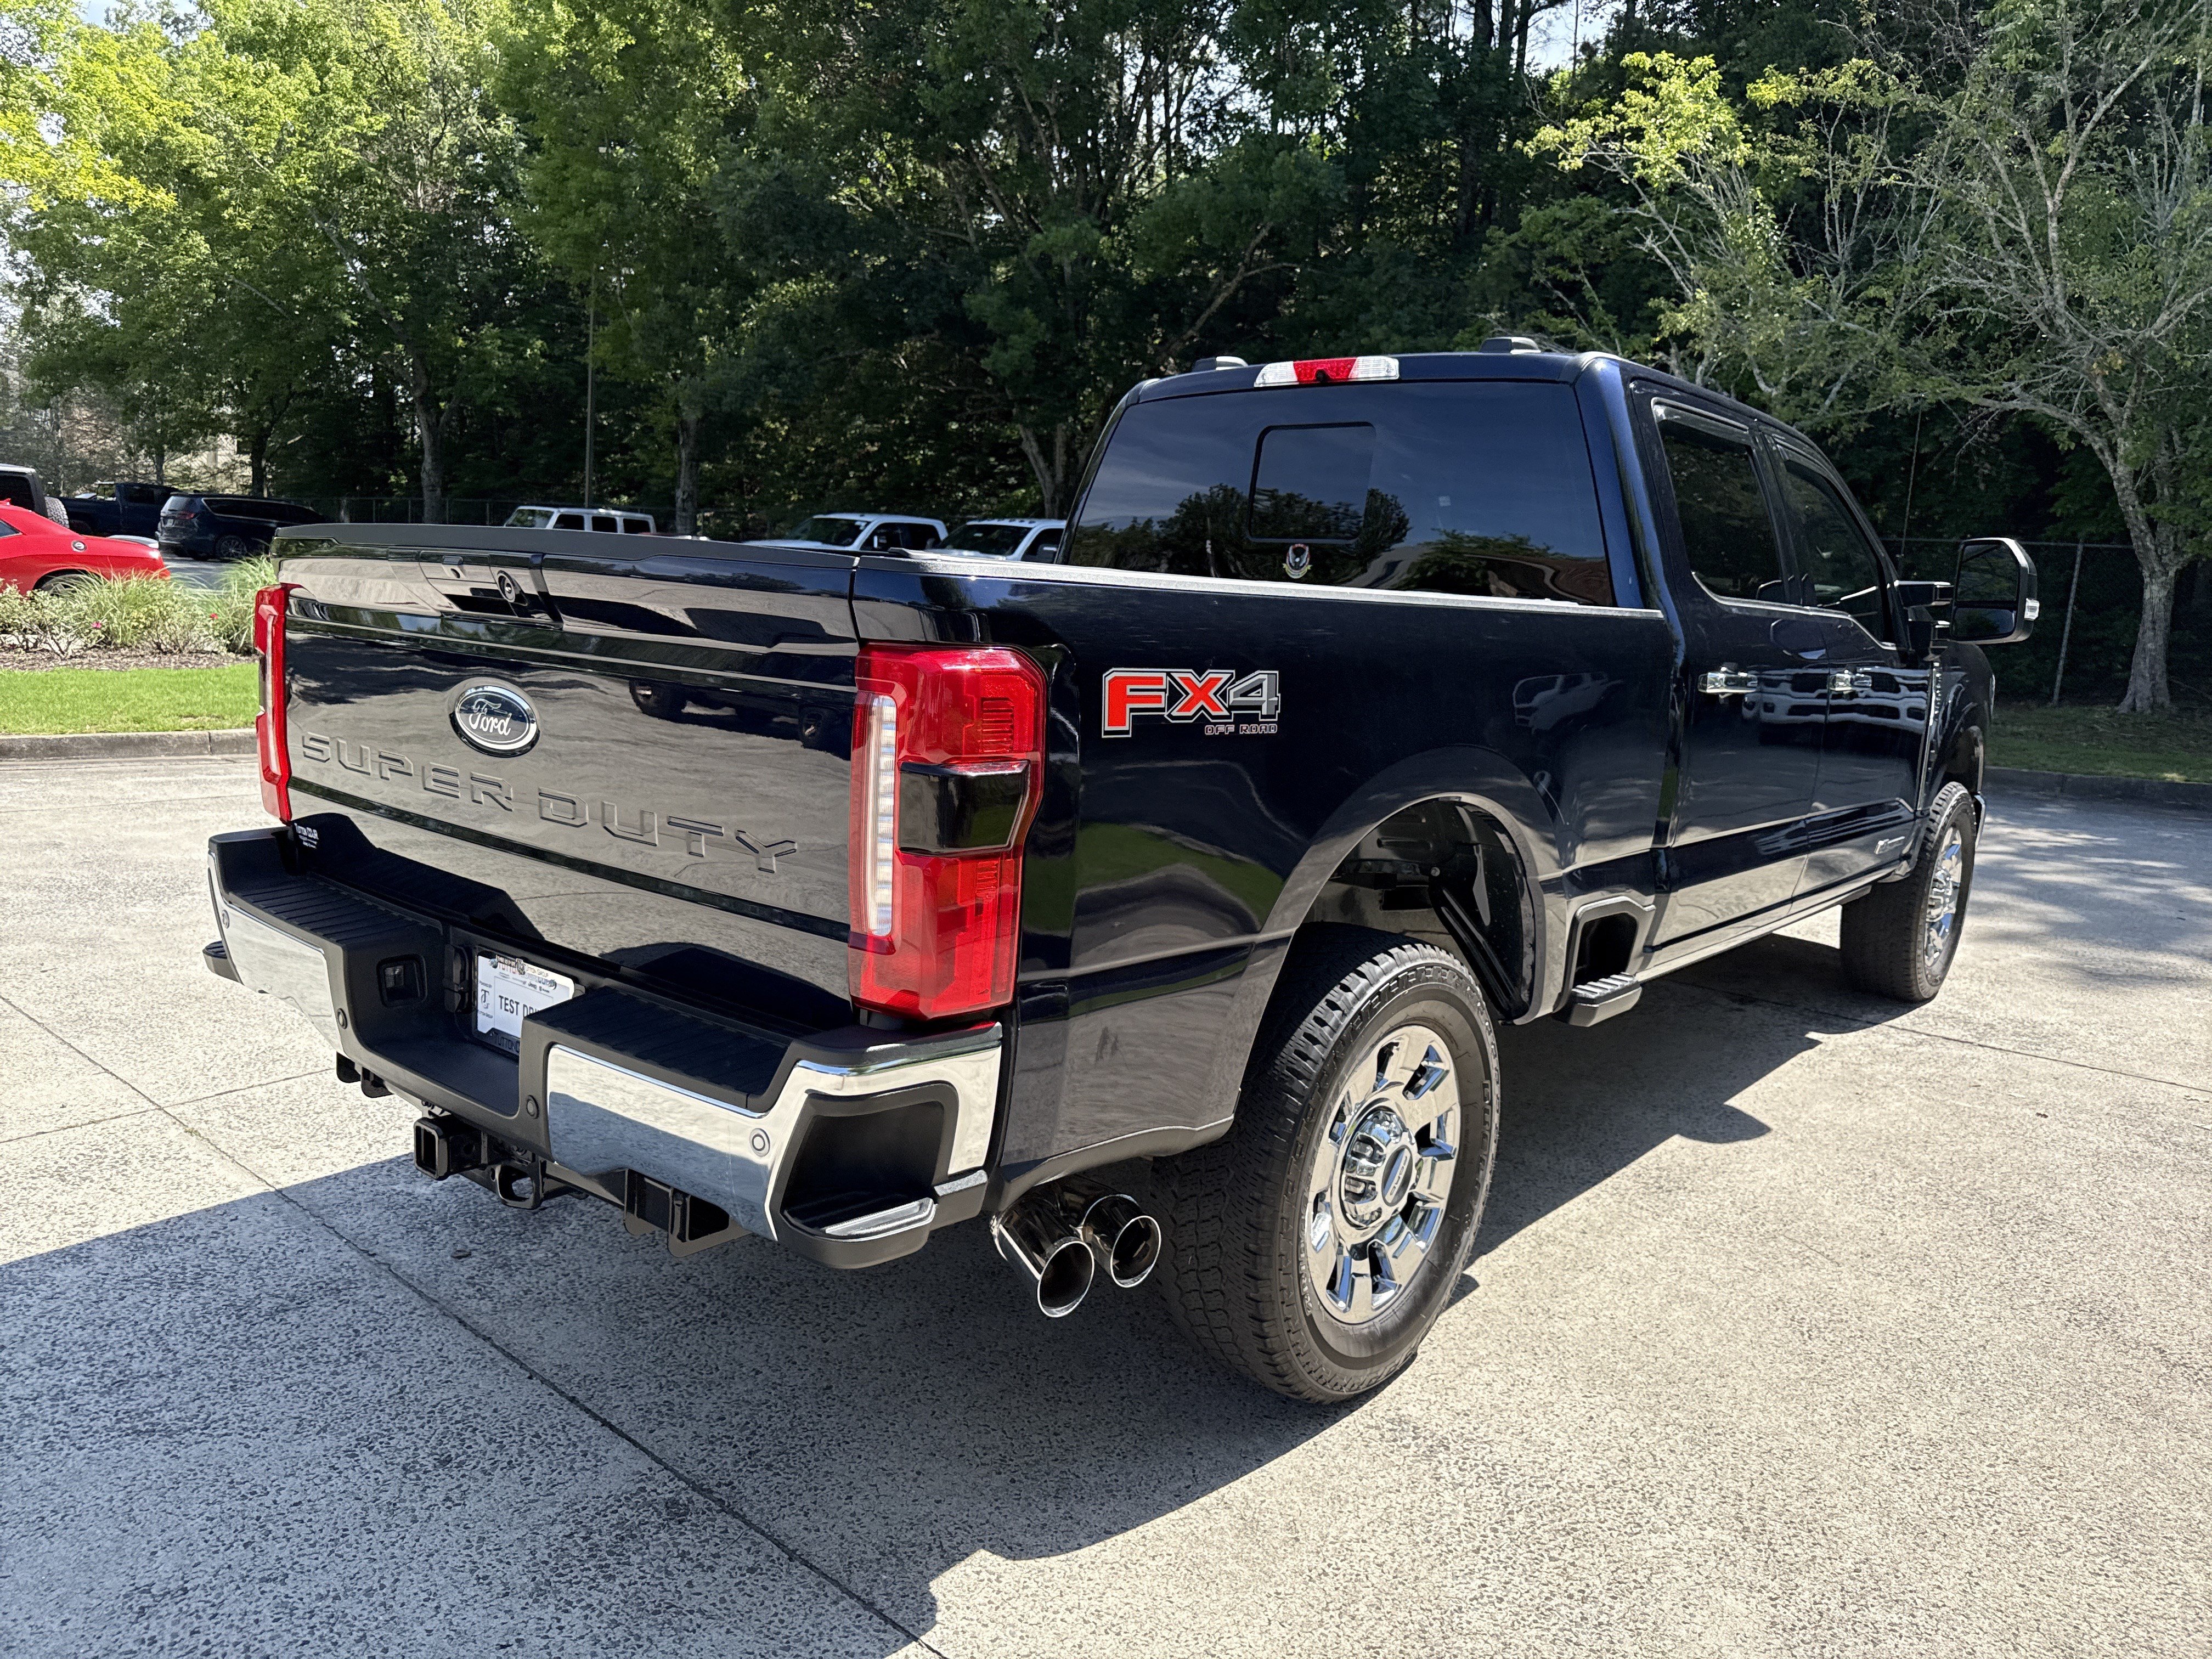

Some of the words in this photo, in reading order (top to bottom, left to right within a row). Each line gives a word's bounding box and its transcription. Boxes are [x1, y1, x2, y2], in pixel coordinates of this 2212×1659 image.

[469, 698, 512, 736] Ford
[1102, 667, 1280, 738] FX4
[1204, 724, 1235, 735] OFF
[1239, 724, 1278, 735] ROAD
[302, 731, 514, 812] SUPER
[538, 786, 798, 873] DUTY
[498, 994, 520, 1016] TEST
[1390, 1155, 1408, 1196] FORD
